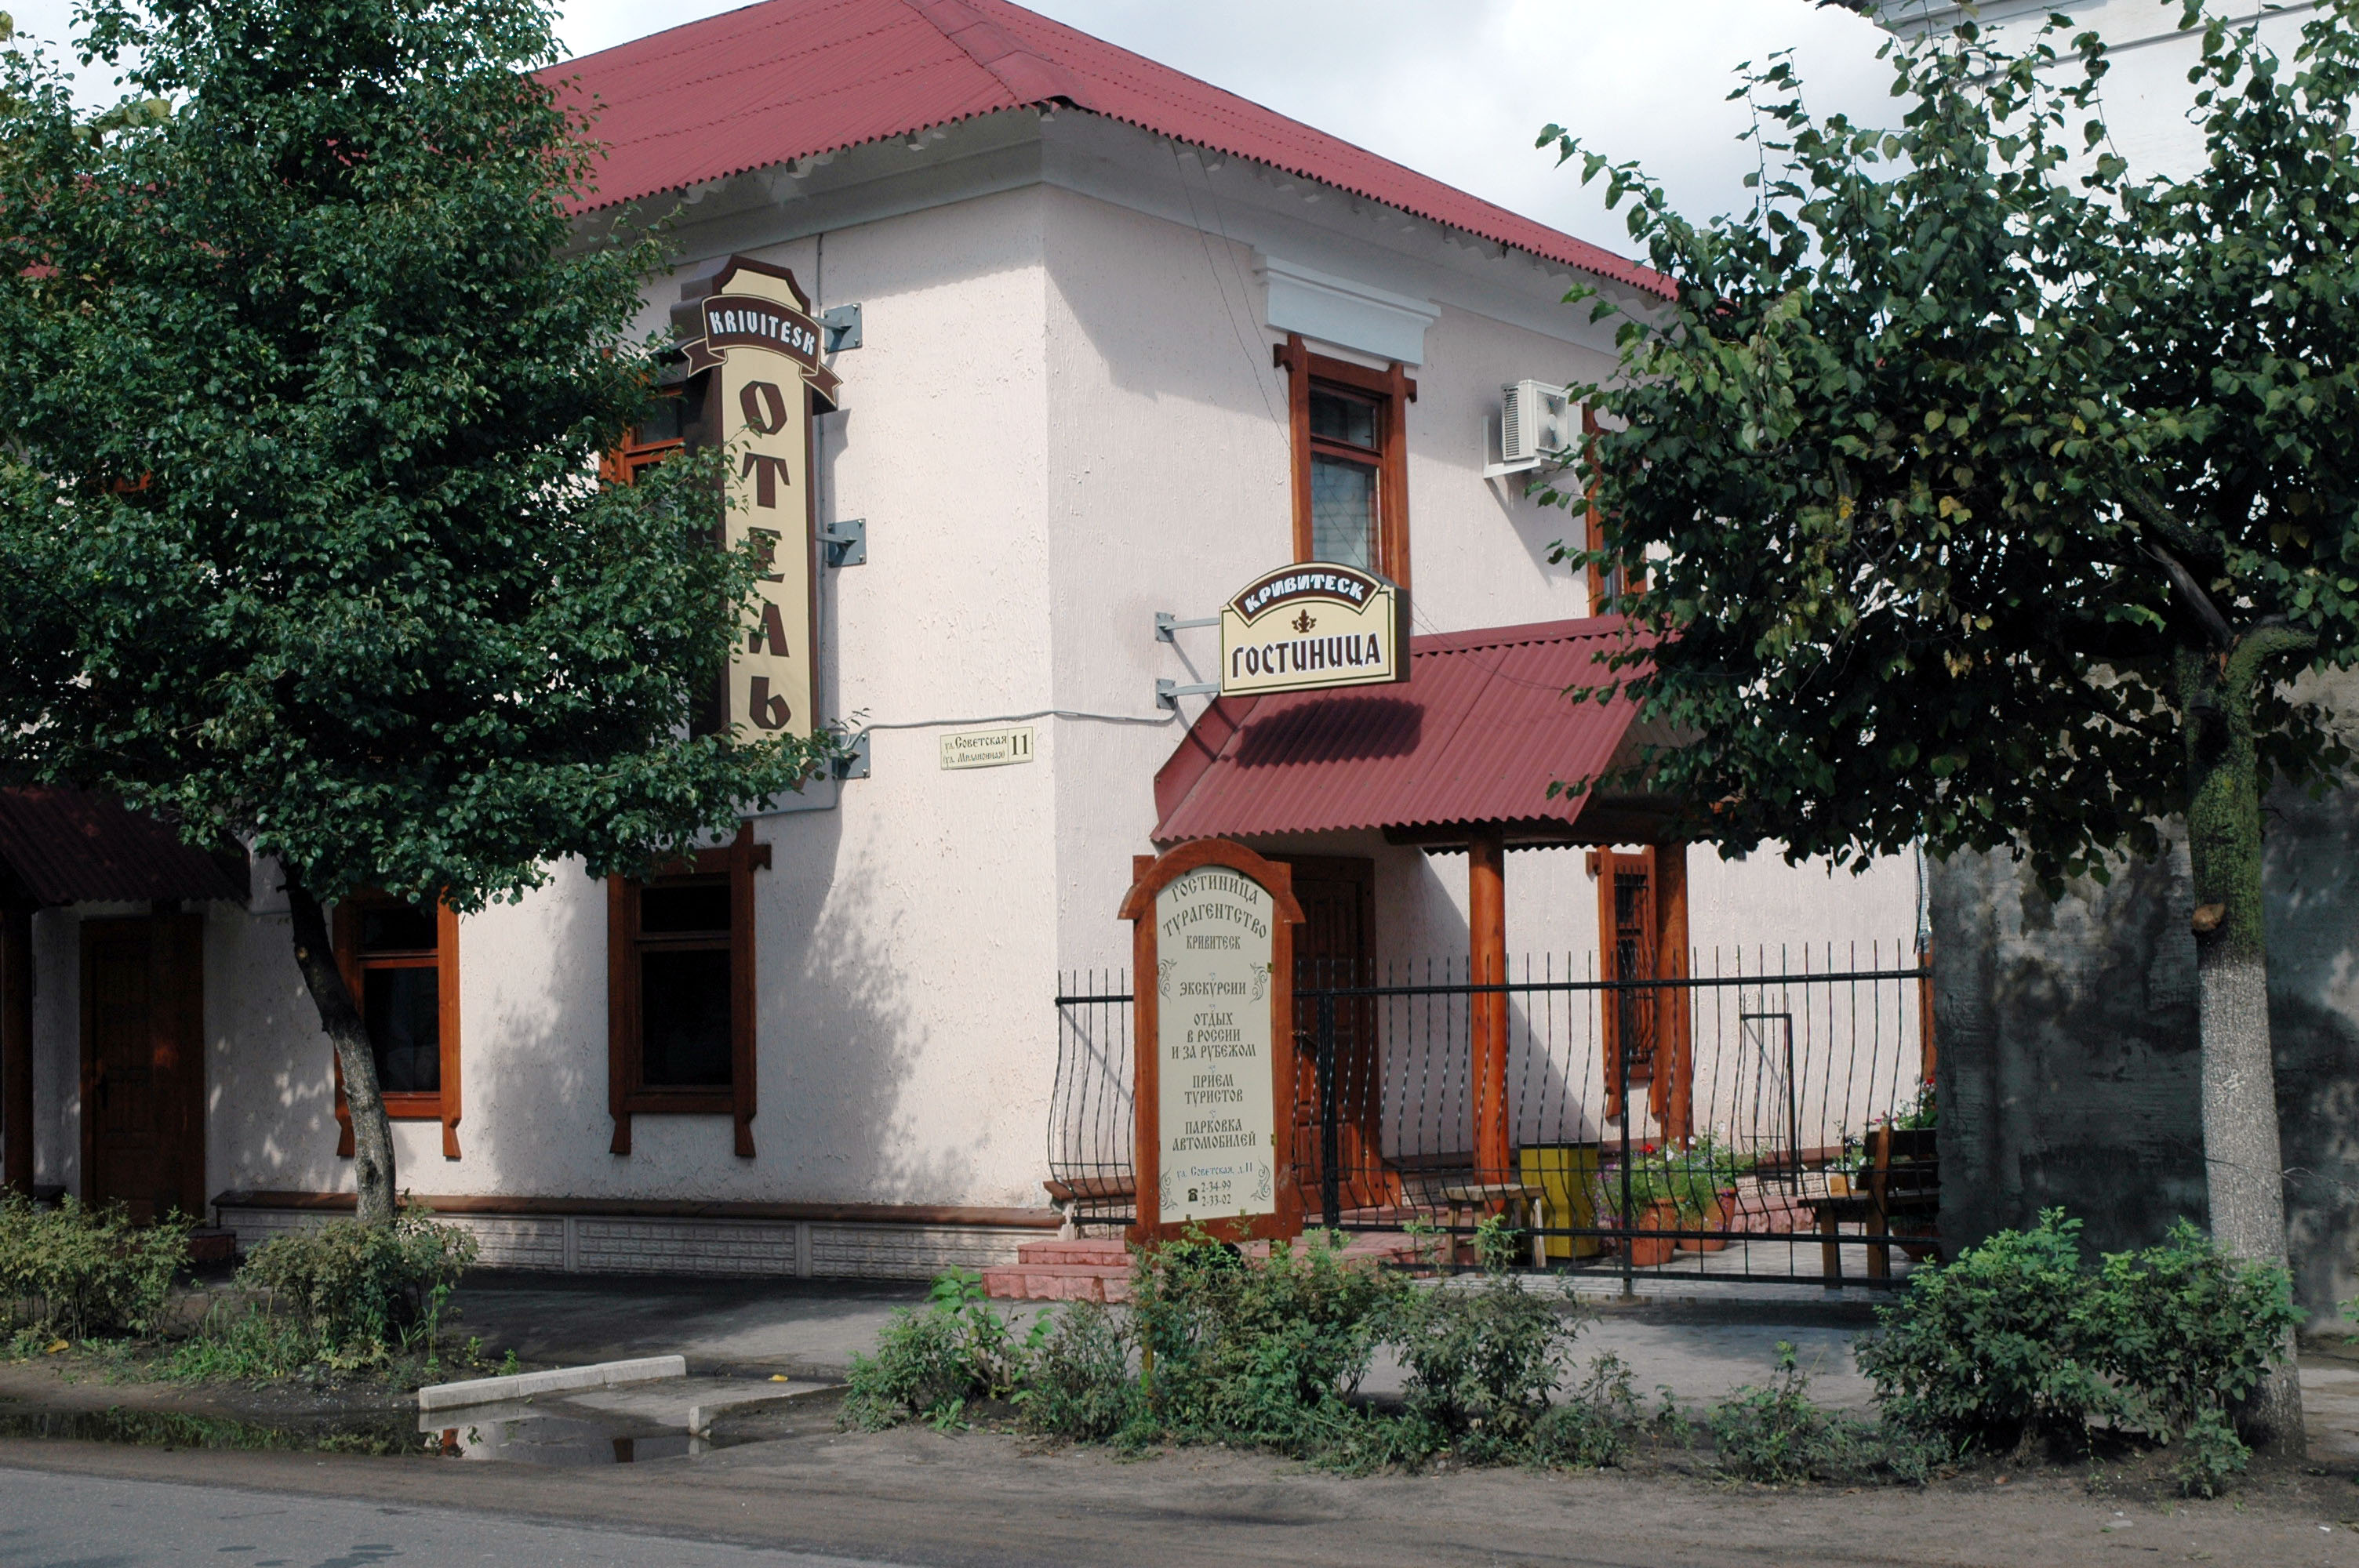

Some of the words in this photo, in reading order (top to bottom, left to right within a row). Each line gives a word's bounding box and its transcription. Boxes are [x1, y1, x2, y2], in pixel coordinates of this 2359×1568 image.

[709, 310, 816, 356] KRIVITESK
[740, 380, 791, 730] ОТЕЛЬ
[1244, 574, 1365, 613] КРИВИТЕСК
[1231, 633, 1381, 678] ГОСТИНИЦА
[1012, 734, 1029, 755] 11
[1171, 875, 1258, 904] ГОСТИНИЦА
[1163, 903, 1267, 938] ТУРАГЕНТСТВО
[1187, 935, 1241, 949] КРИВИТЕСК
[1180, 982, 1246, 997] ЭКСКУРСИИ
[1194, 1011, 1234, 1028] ОТДЫХ
[1198, 1029, 1241, 1042] РОССИИ
[1172, 1046, 1180, 1059] И
[1183, 1045, 1197, 1060] ЗА
[1201, 1044, 1256, 1062] РУБЕЖОМ
[1193, 1074, 1234, 1088] ПРИЕМ
[1184, 1089, 1243, 1108] ТУРИСТОВ
[1185, 1119, 1243, 1134] ПАРКОВКА
[1172, 1131, 1256, 1151] АВТОМОБИЛЕЙ
[1201, 1180, 1231, 1192] 2-34-99
[1201, 1194, 1231, 1207] 2-33-02
